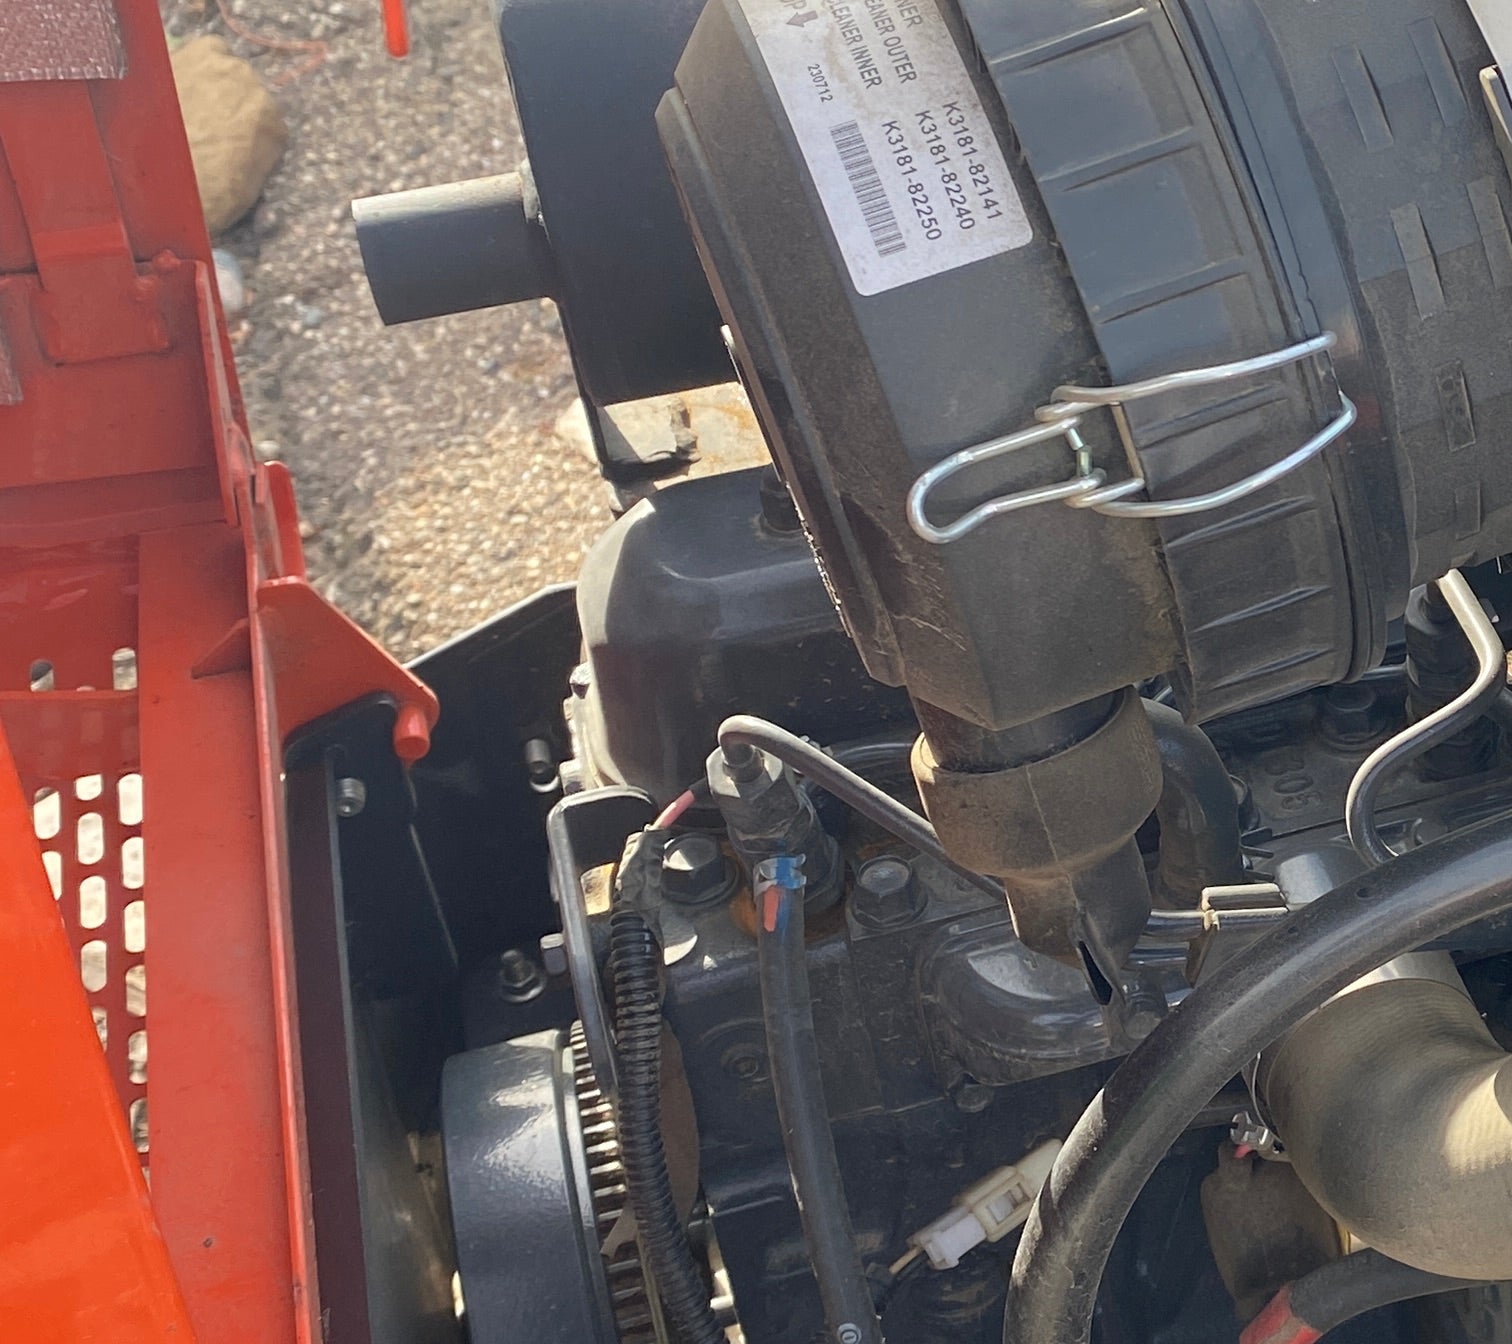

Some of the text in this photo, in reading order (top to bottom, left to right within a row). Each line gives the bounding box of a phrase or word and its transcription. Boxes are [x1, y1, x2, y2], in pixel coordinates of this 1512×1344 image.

[807, 62, 834, 103] 230712
[849, 44, 883, 90] INNER
[882, 34, 918, 84] OUTER
[881, 119, 943, 242] K3181-82250
[915, 109, 977, 231] K3181-82240
[942, 99, 1003, 220] K3181-82141
